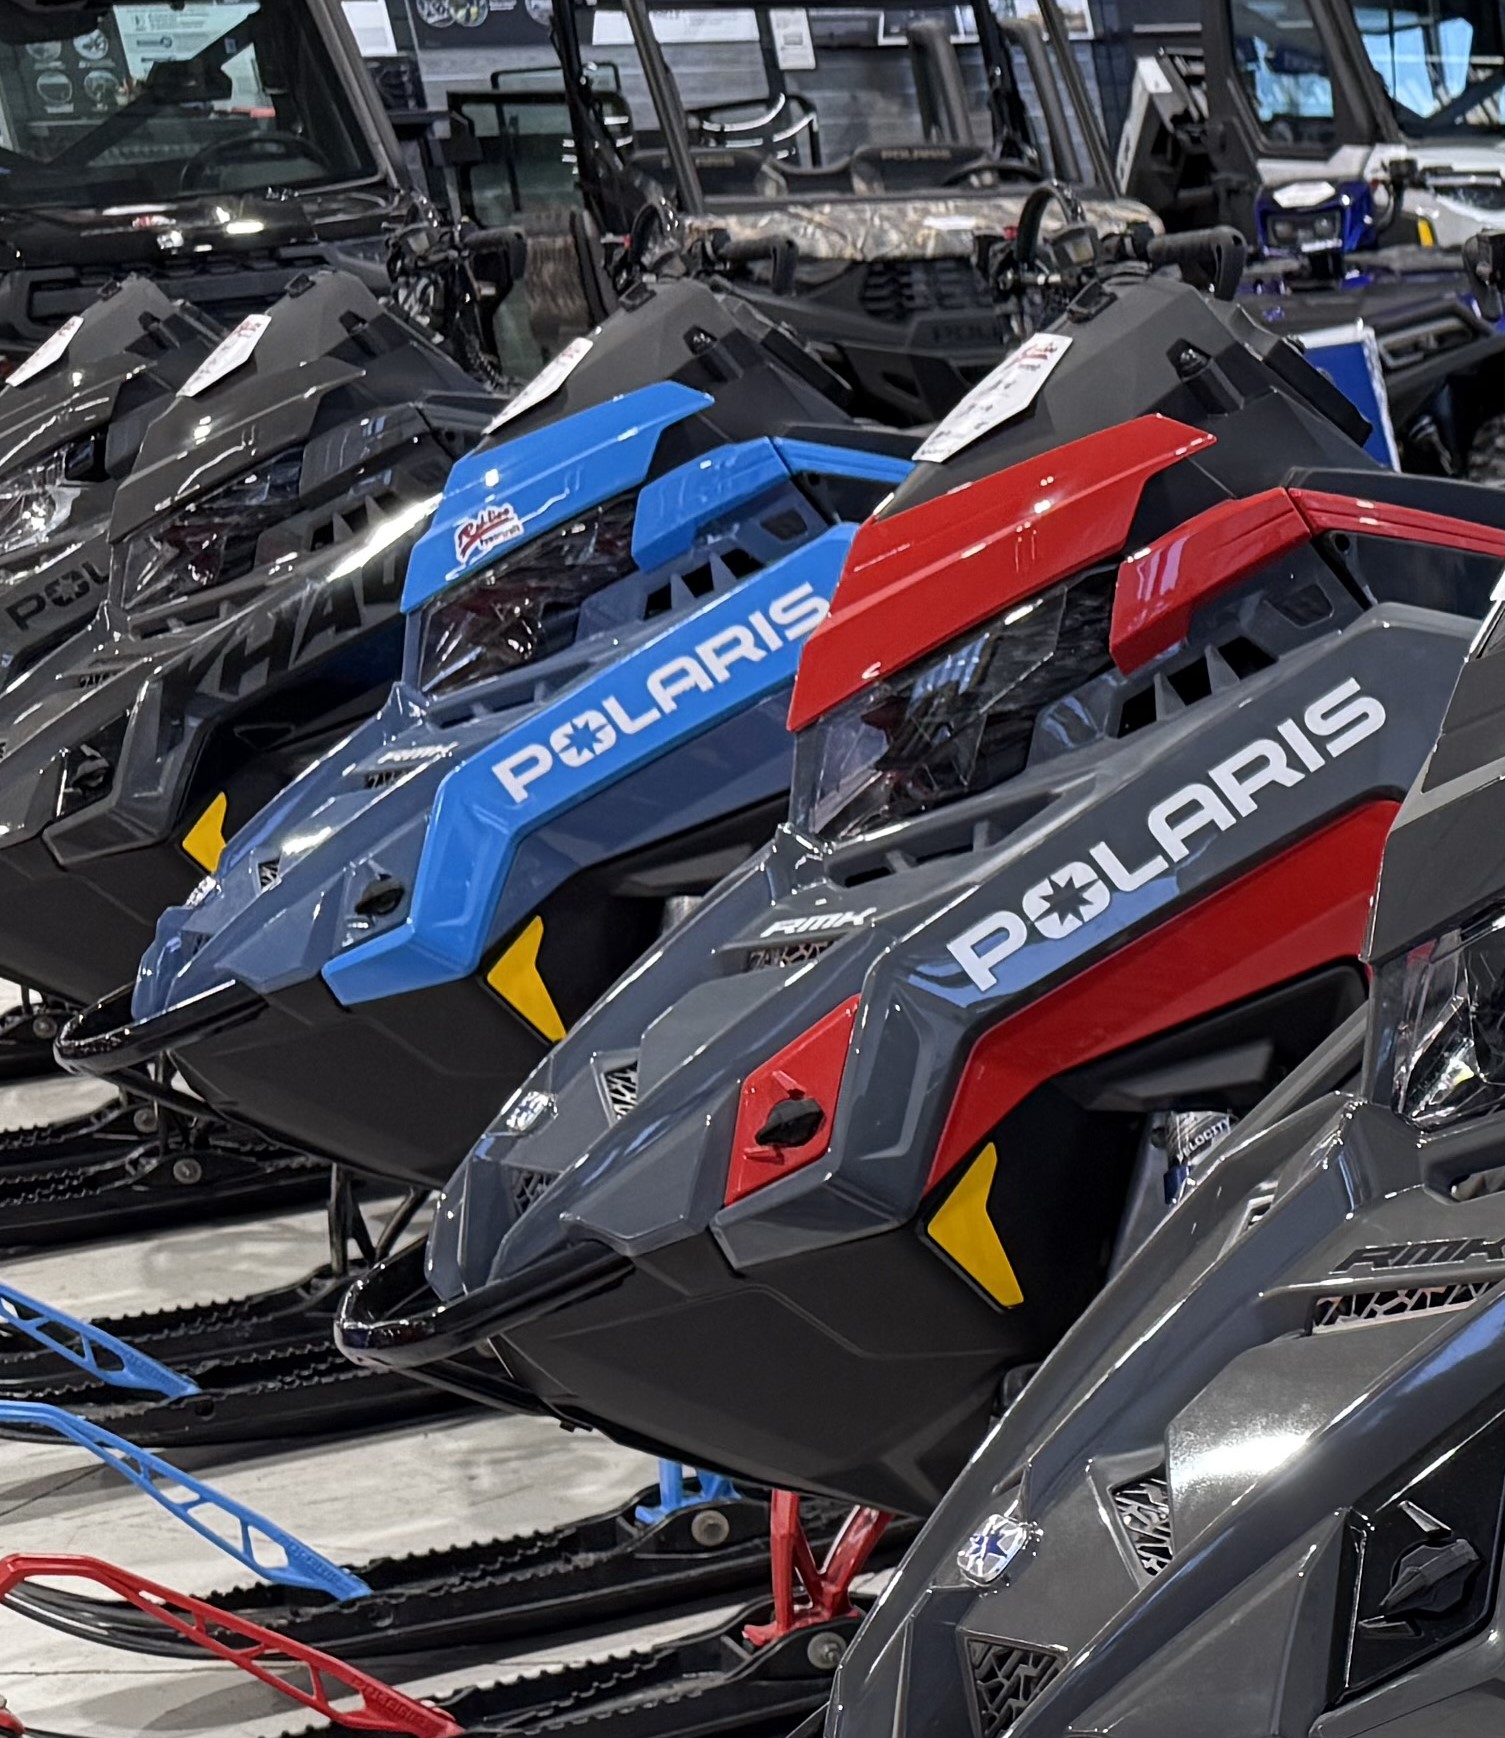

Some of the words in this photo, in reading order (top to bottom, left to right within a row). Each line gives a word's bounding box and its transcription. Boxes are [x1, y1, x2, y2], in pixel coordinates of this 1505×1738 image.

[491, 580, 831, 804] POLARIS
[759, 906, 878, 939] RMK
[946, 676, 1387, 992] POLARIS
